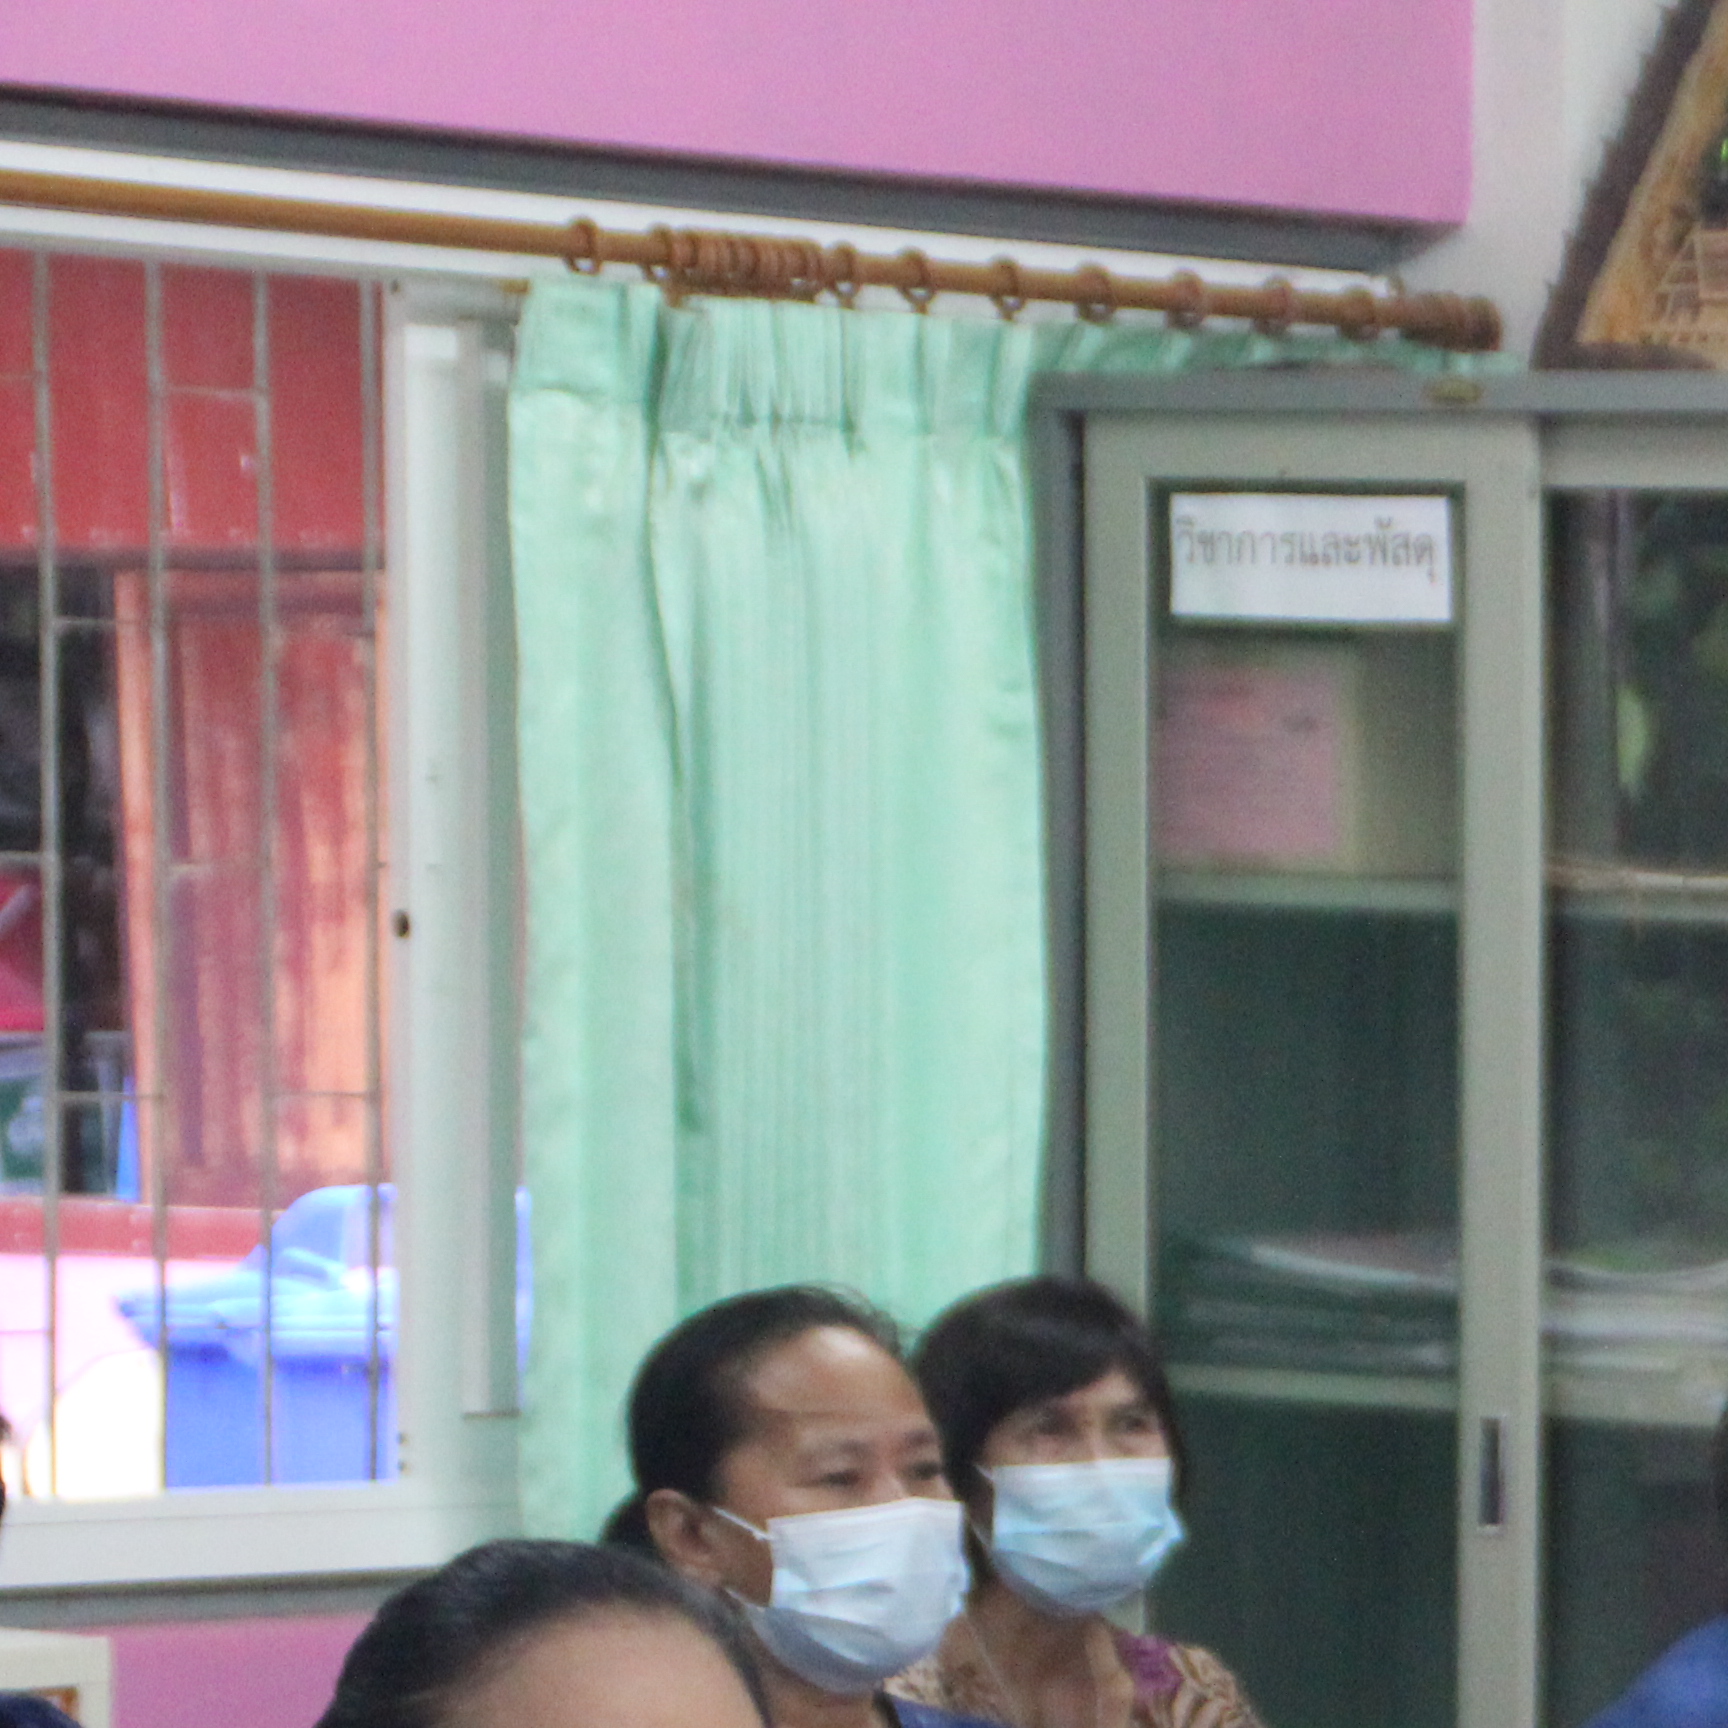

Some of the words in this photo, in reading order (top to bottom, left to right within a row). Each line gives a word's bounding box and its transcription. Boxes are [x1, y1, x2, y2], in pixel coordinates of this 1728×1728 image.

[1175, 515, 1438, 584] วิชาการและพัสดุ
